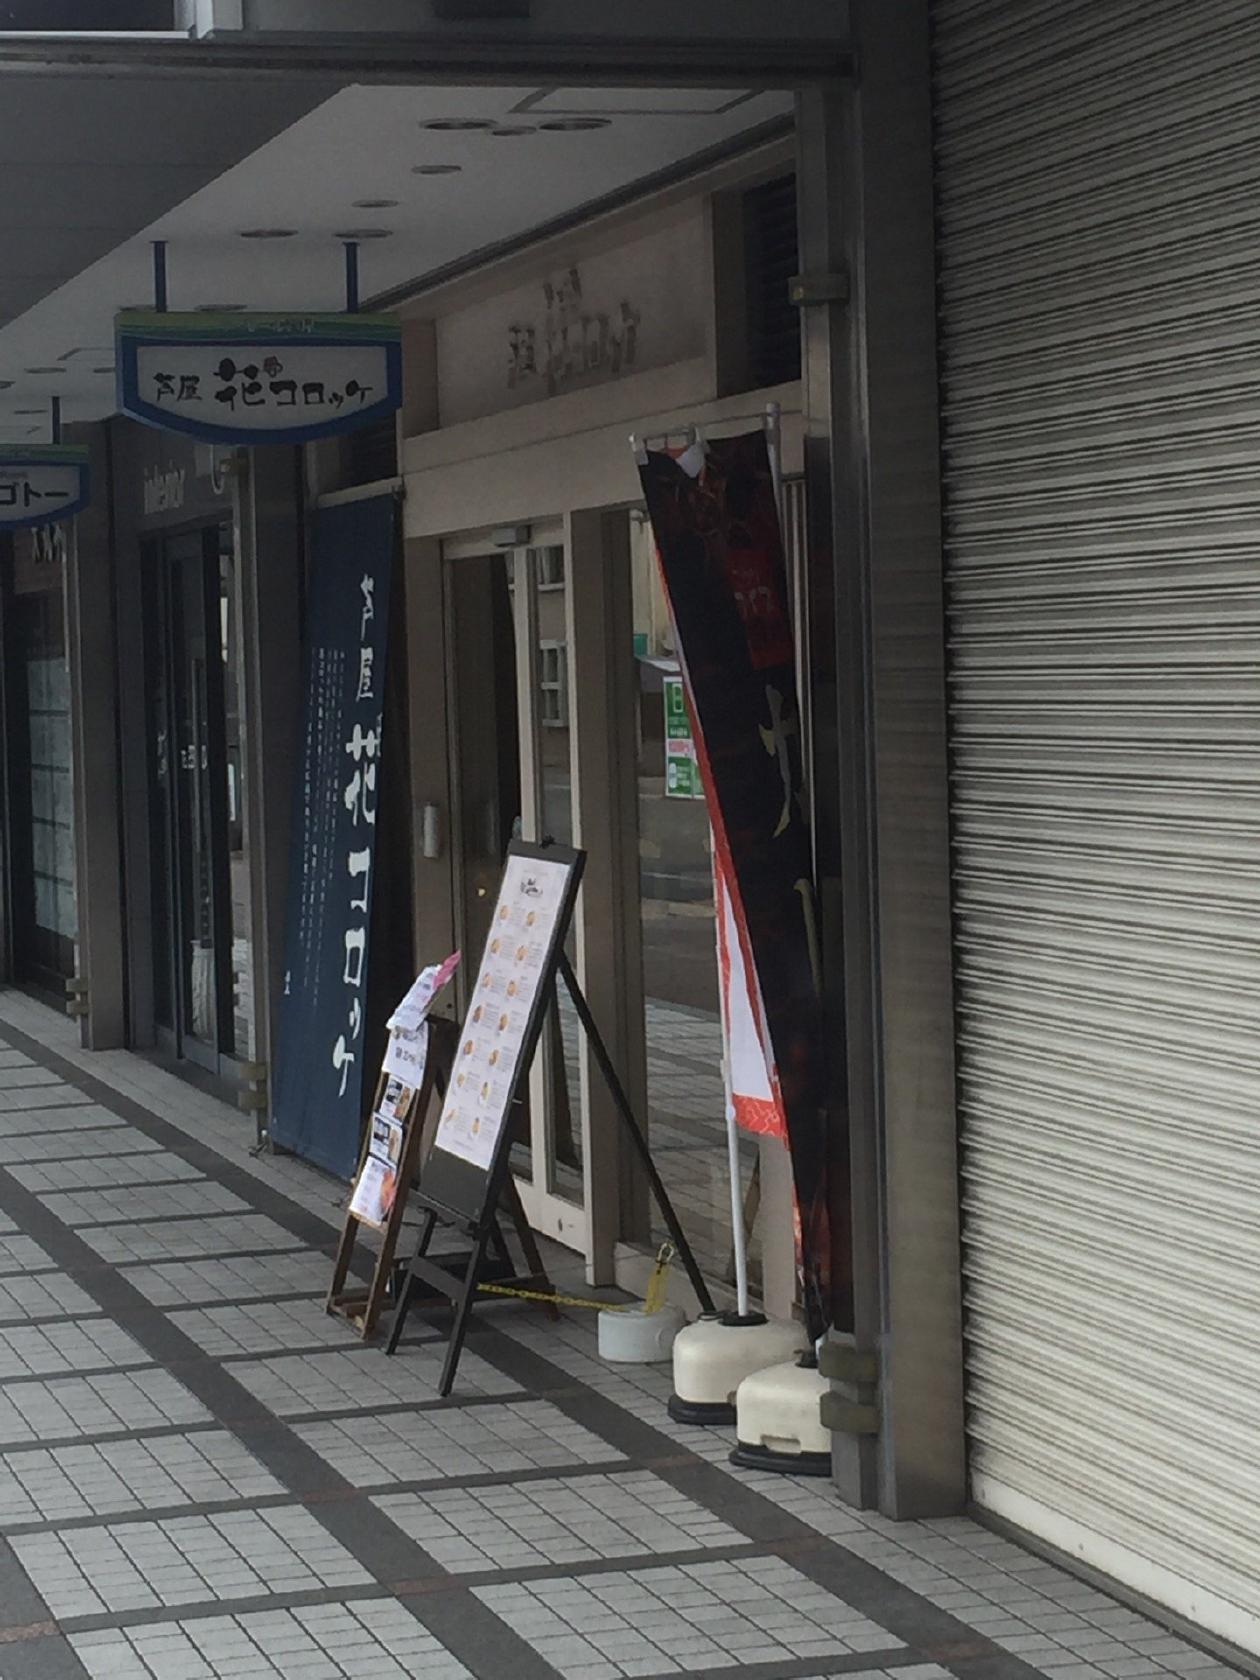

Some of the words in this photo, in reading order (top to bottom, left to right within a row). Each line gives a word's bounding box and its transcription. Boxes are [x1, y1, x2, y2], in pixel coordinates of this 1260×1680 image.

[153, 371, 202, 401] 芦屋
[331, 722, 381, 1098] 花コロッケ
